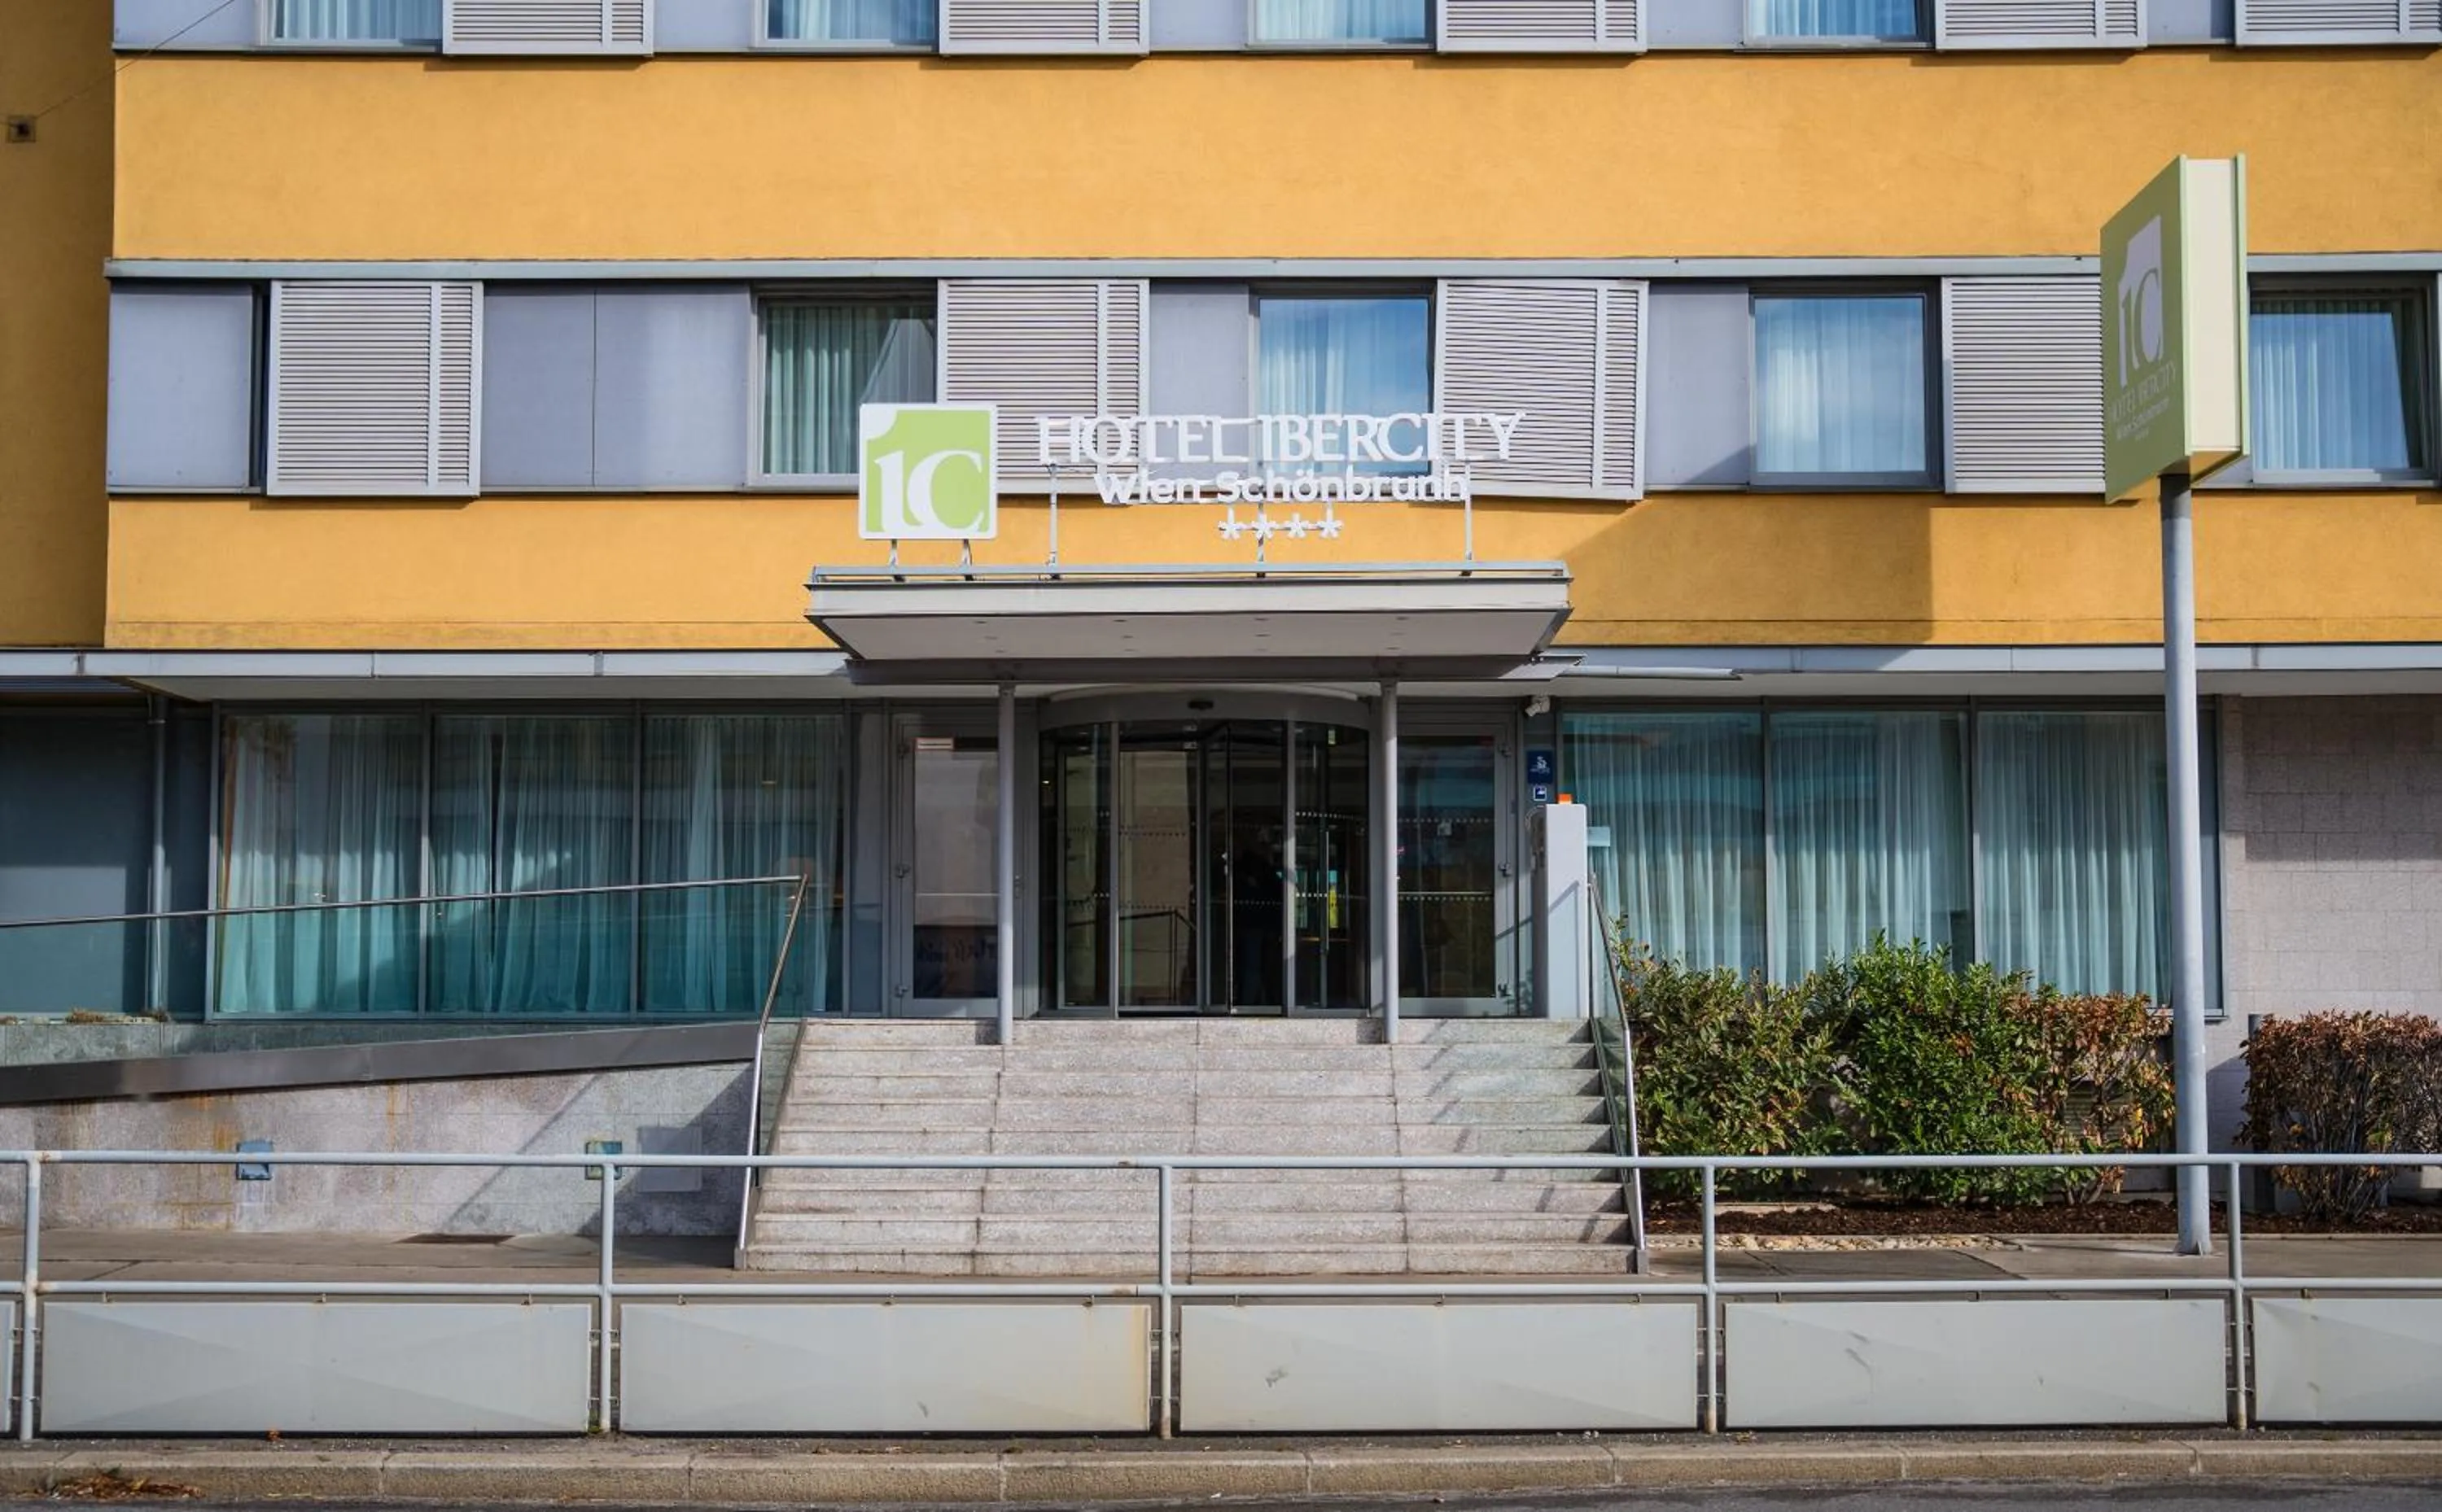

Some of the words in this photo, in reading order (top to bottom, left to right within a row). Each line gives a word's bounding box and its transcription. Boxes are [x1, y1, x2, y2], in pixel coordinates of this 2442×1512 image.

[1035, 413, 1249, 465] HOTEL
[1256, 411, 1527, 463] IBERCITY
[1093, 469, 1201, 504] Wien
[1215, 463, 1465, 504] Schönbrunn
